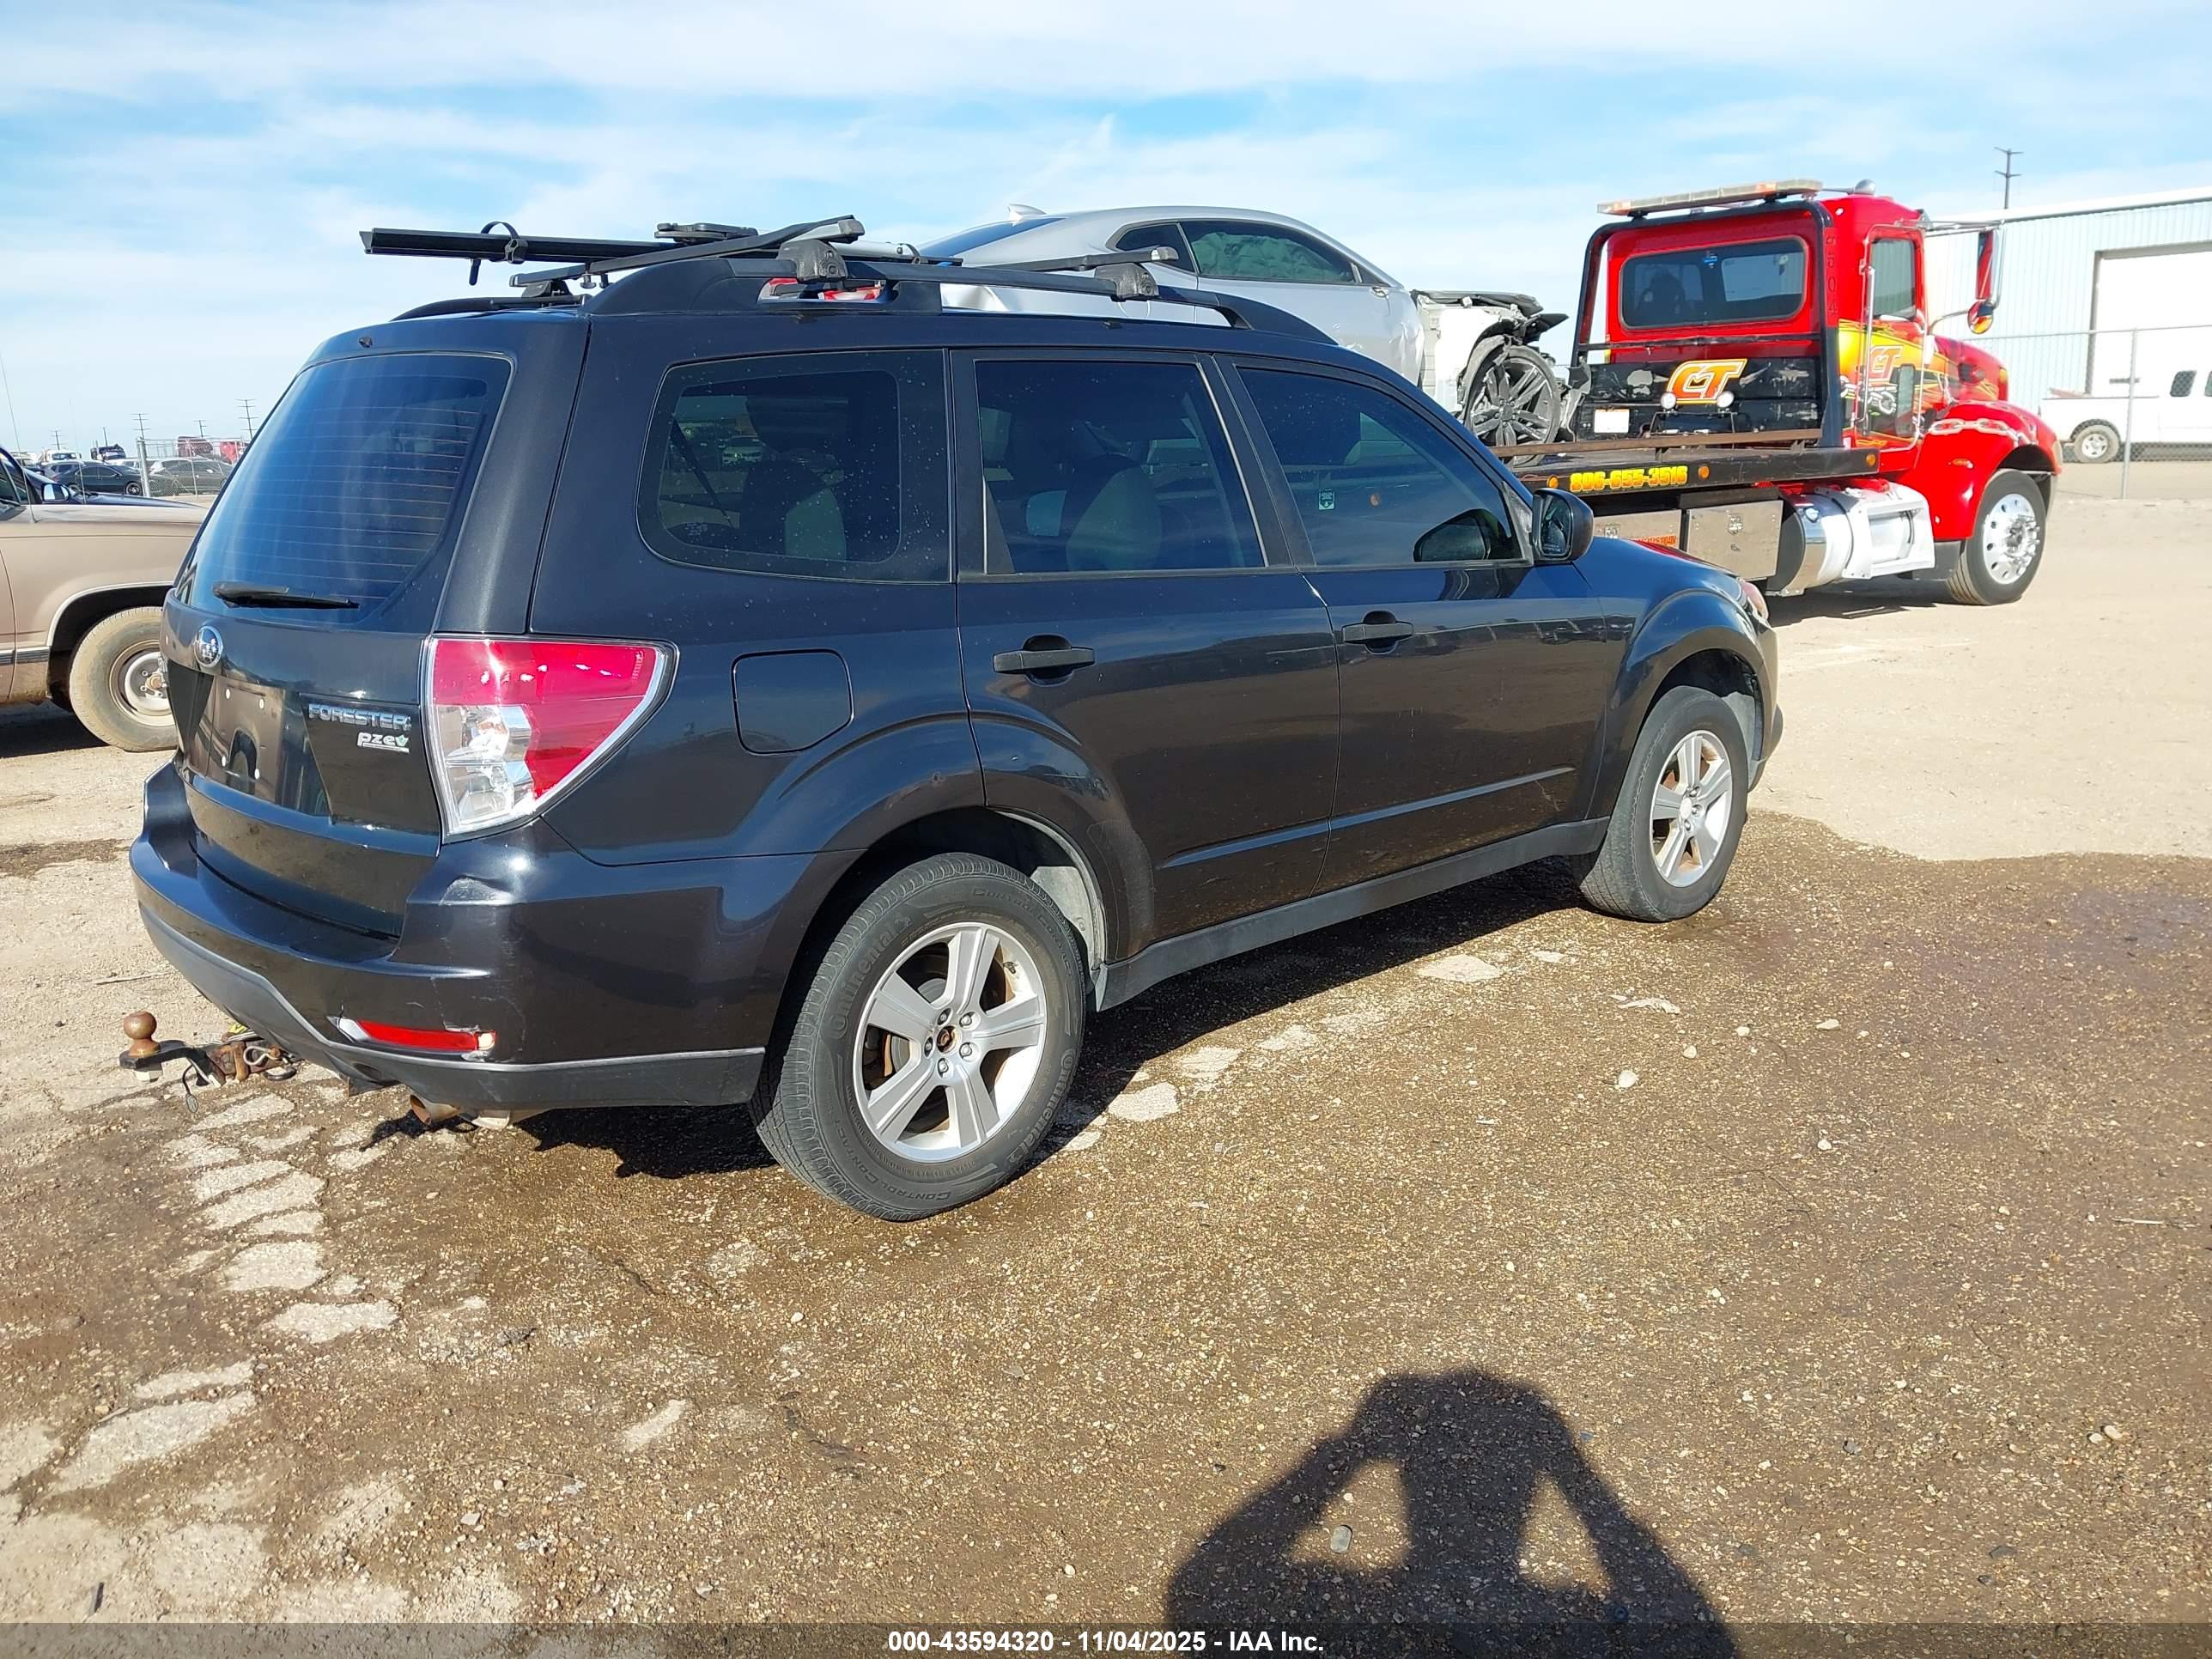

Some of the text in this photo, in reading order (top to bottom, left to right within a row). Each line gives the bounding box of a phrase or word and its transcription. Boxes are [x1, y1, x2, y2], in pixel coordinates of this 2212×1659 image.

[1666, 359, 1747, 405] CT
[1570, 465, 1688, 493] 806-655-3516
[308, 703, 411, 731] FORESTER
